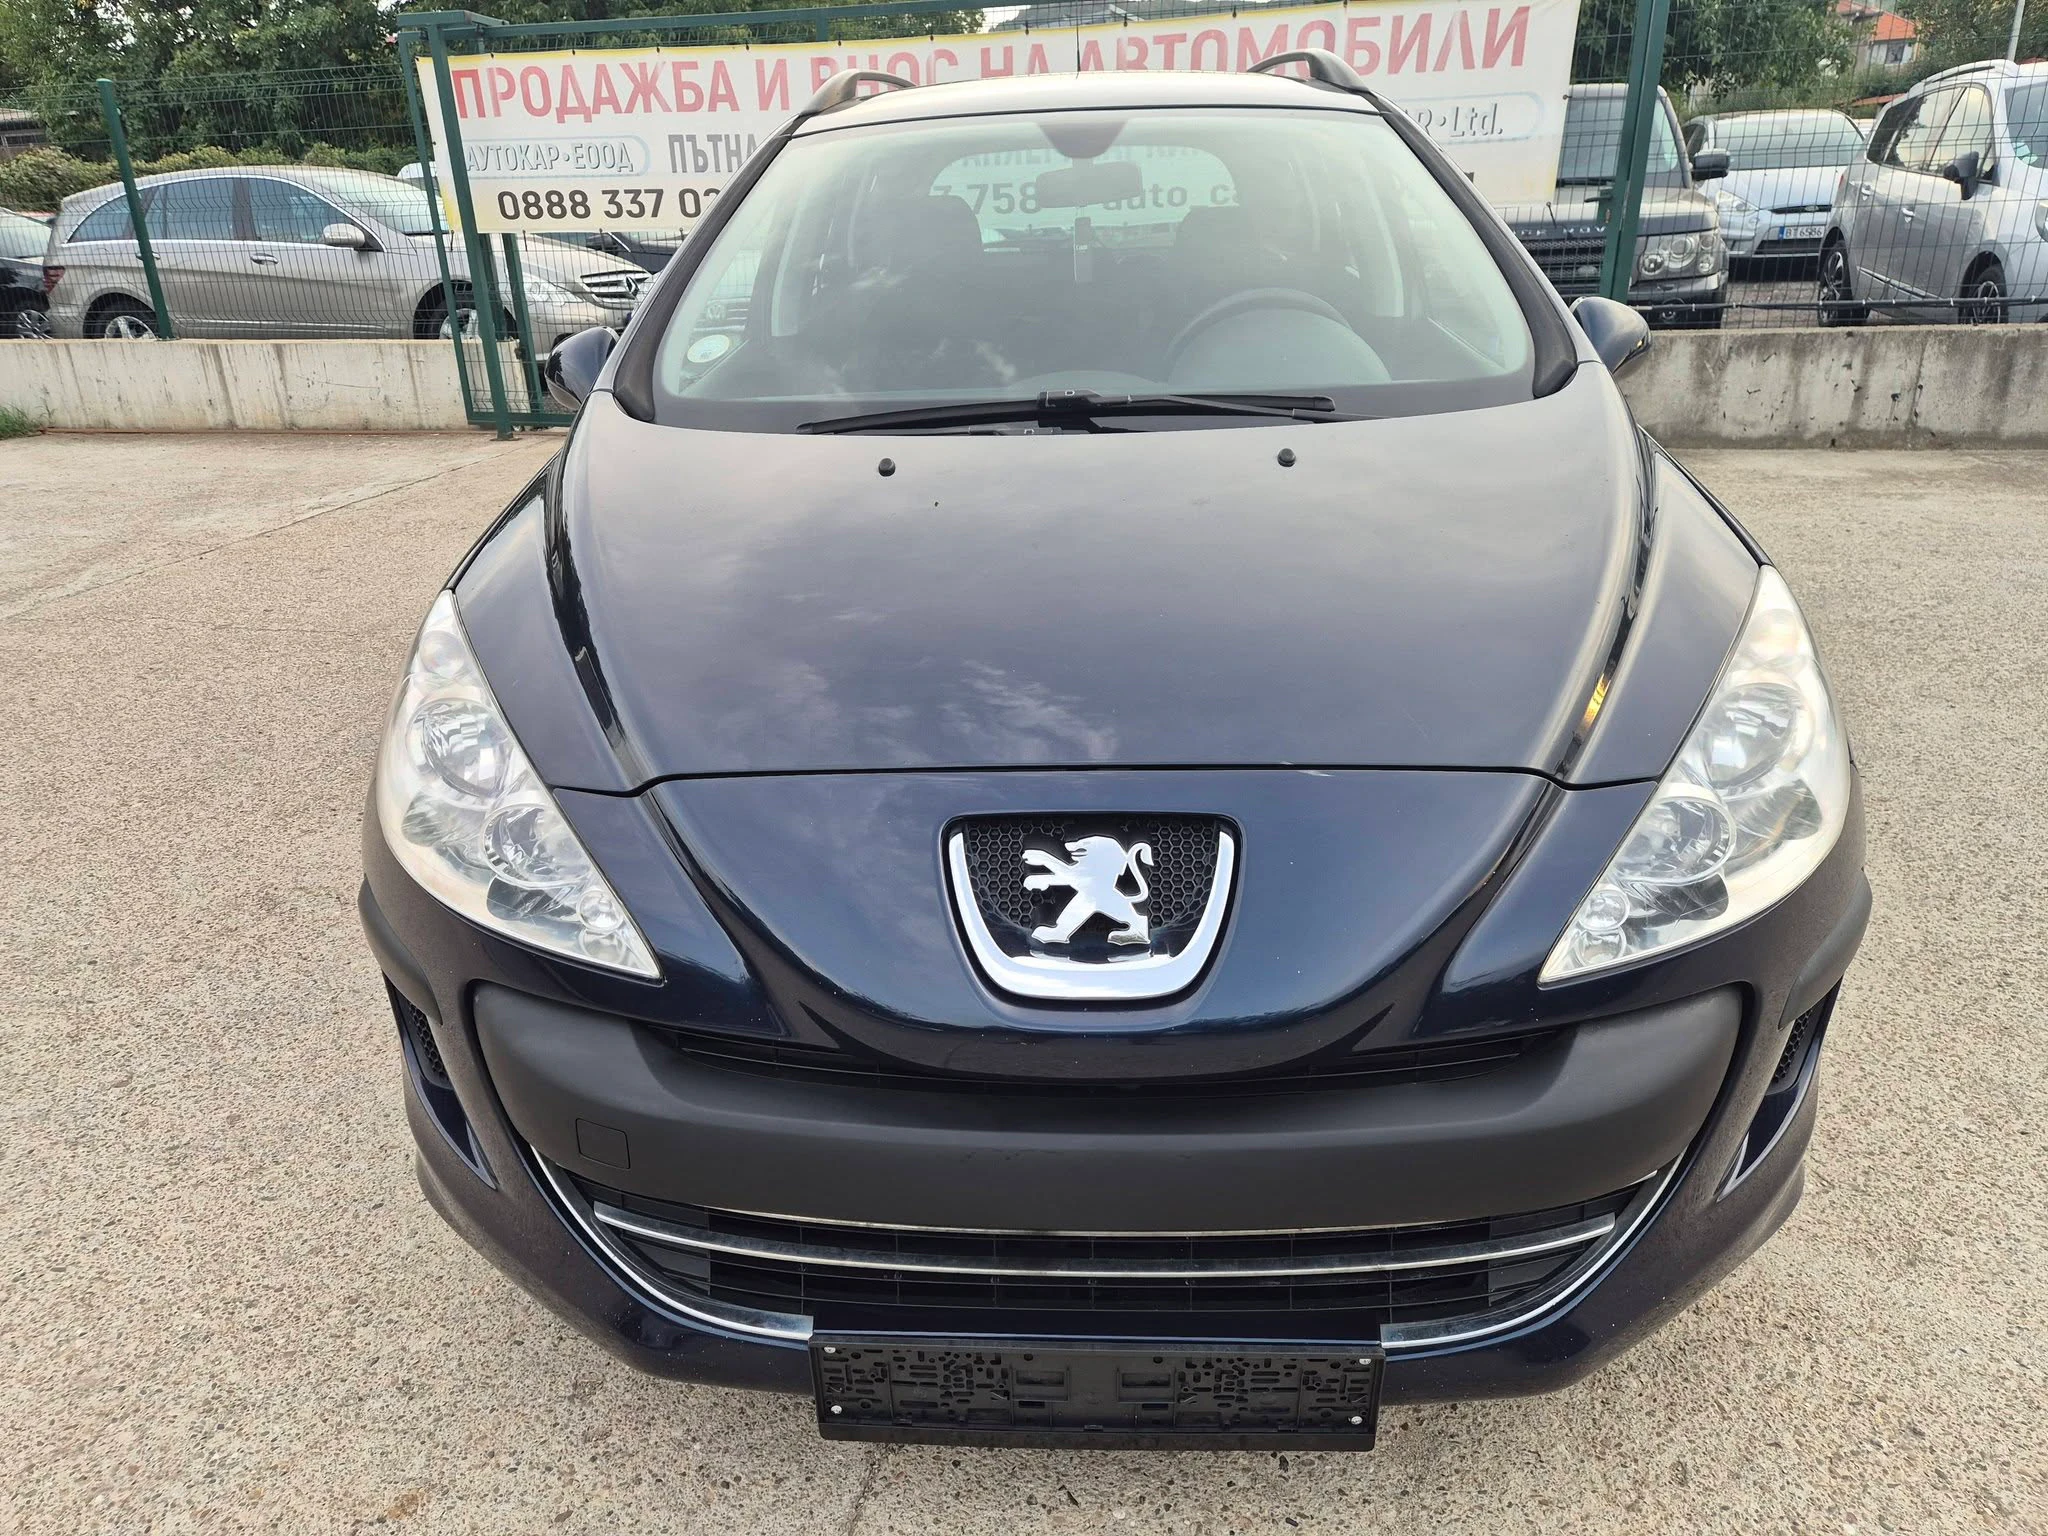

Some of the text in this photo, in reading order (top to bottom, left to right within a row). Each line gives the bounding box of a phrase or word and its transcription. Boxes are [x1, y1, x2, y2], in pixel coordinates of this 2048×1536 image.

[452, 58, 740, 124] ПРОДАЖБА
[757, 58, 790, 111] И
[1080, 6, 1530, 79] АВТОМОБИЛИ
[497, 190, 591, 220] 0888
[601, 188, 664, 218] 337
